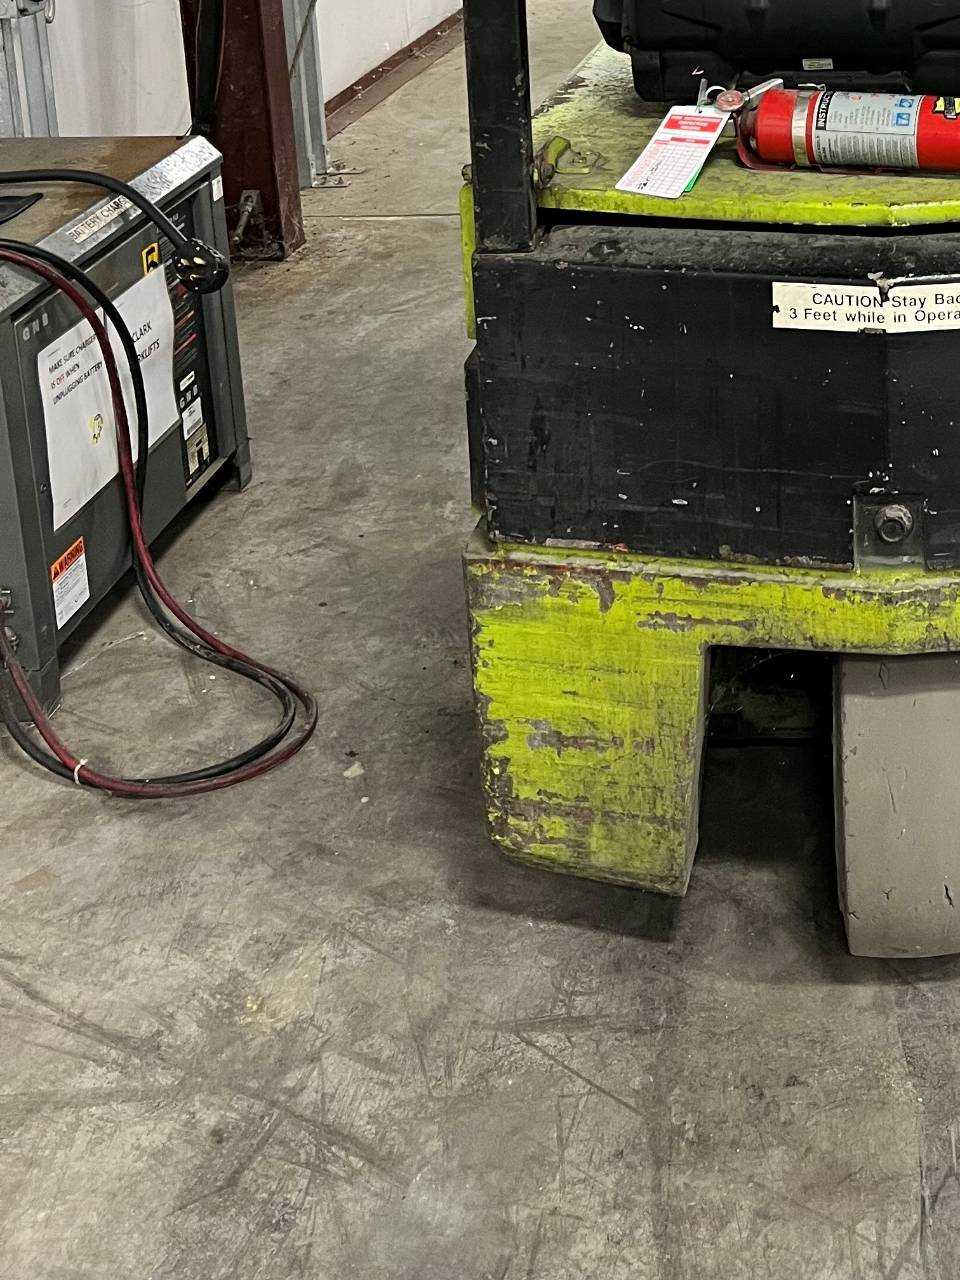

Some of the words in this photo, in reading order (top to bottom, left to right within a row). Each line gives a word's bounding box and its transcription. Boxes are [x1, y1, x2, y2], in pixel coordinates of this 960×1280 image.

[69, 214, 100, 240] BATTERY
[101, 197, 127, 218] CHARG
[812, 293, 884, 307] CAUTION
[891, 295, 926, 307] Stay
[789, 308, 798, 320] 3
[804, 308, 837, 321] Feet
[845, 311, 885, 324] while
[893, 312, 907, 323] in
[132, 320, 153, 343] CLARK
[48, 359, 62, 373] MAKE
[63, 349, 75, 363] SURE
[137, 338, 160, 361] RKLIFTS
